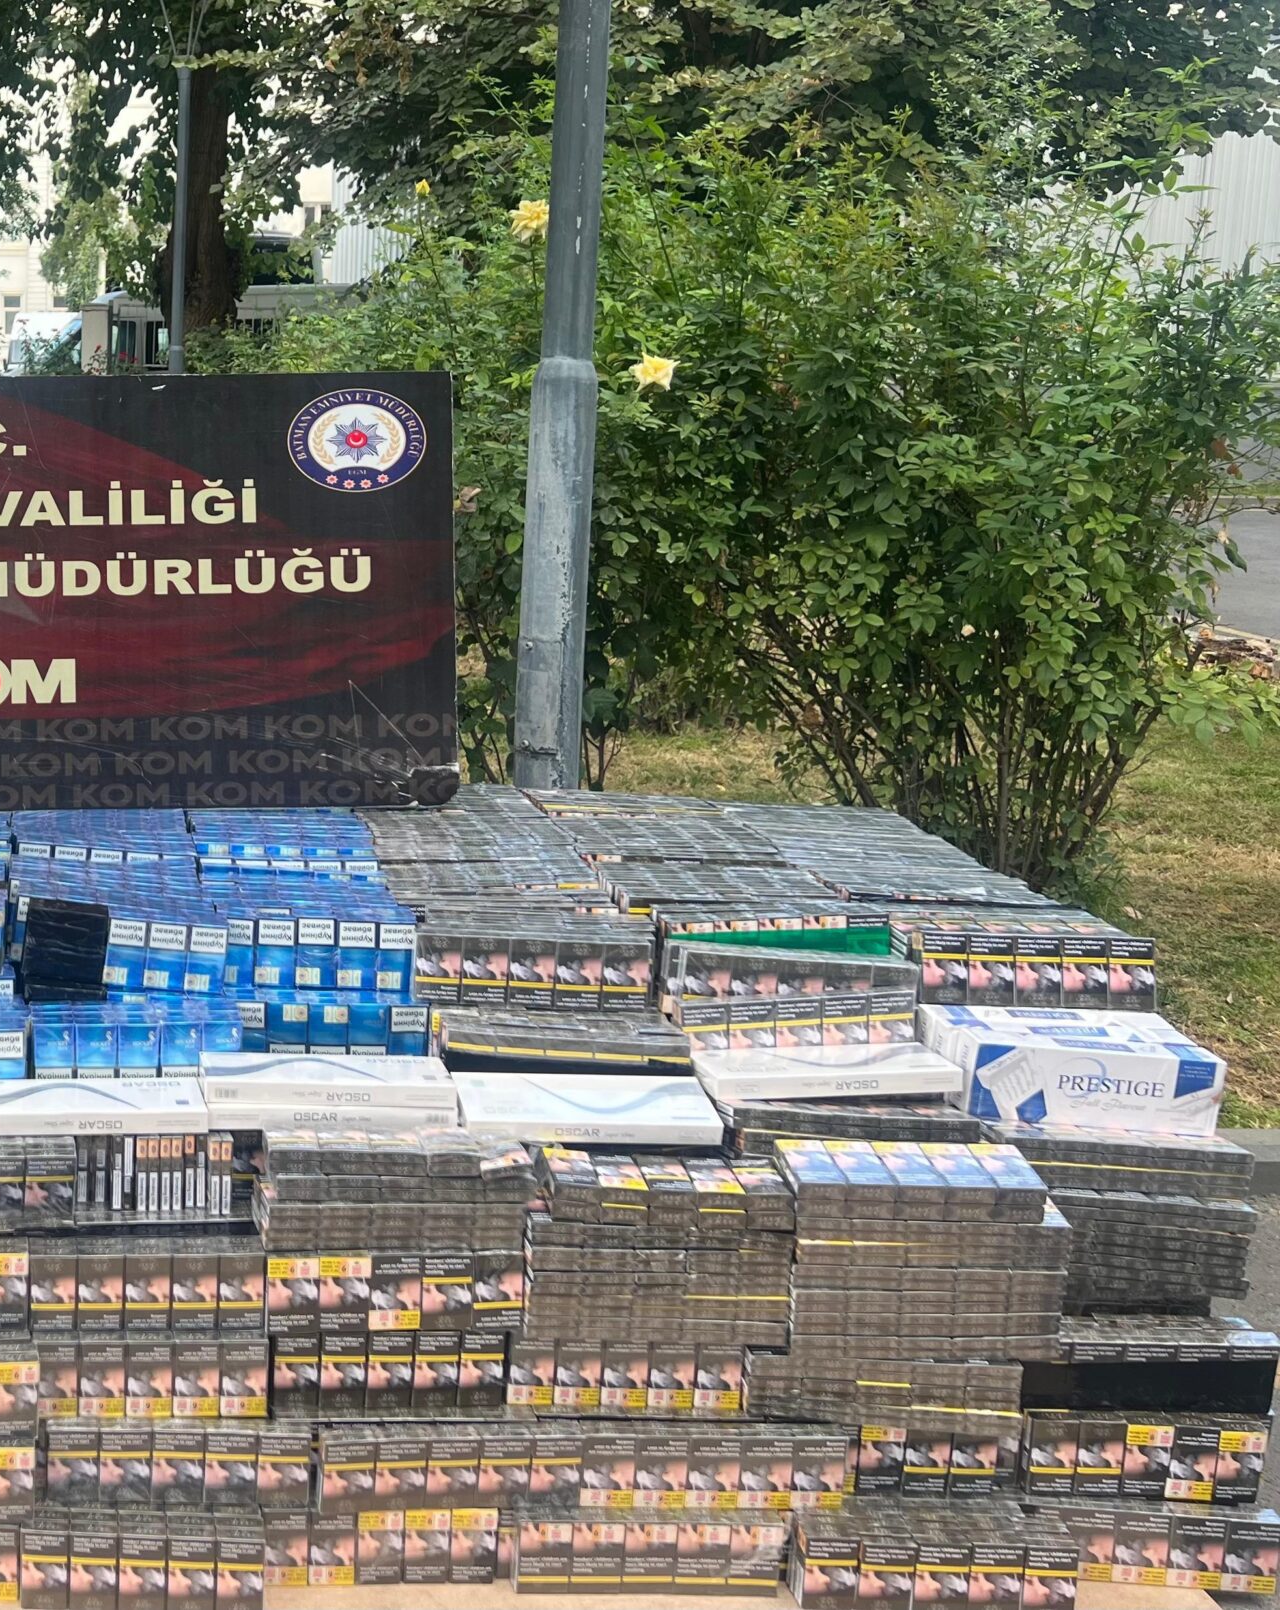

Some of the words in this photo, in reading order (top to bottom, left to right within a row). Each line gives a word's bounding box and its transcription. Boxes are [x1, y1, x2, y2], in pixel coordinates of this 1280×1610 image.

[311, 392, 374, 416] EMNİYET
[36, 717, 134, 742] KOM
[151, 715, 248, 740] KOM
[264, 714, 362, 739] KOM
[0, 752, 99, 777] KOM
[115, 750, 212, 776] KOM
[229, 749, 327, 774] KOM
[73, 783, 170, 808] KOM
[187, 781, 284, 806] KOM
[300, 779, 400, 805] KOM
[835, 1079, 879, 1090] OSCAR
[1057, 1074, 1167, 1099] PRESTIGE
[326, 1091, 371, 1102] OSCAR
[78, 1120, 123, 1129] OSCAR
[293, 1112, 338, 1122] OSCAR
[554, 1127, 601, 1137] OSCAR
